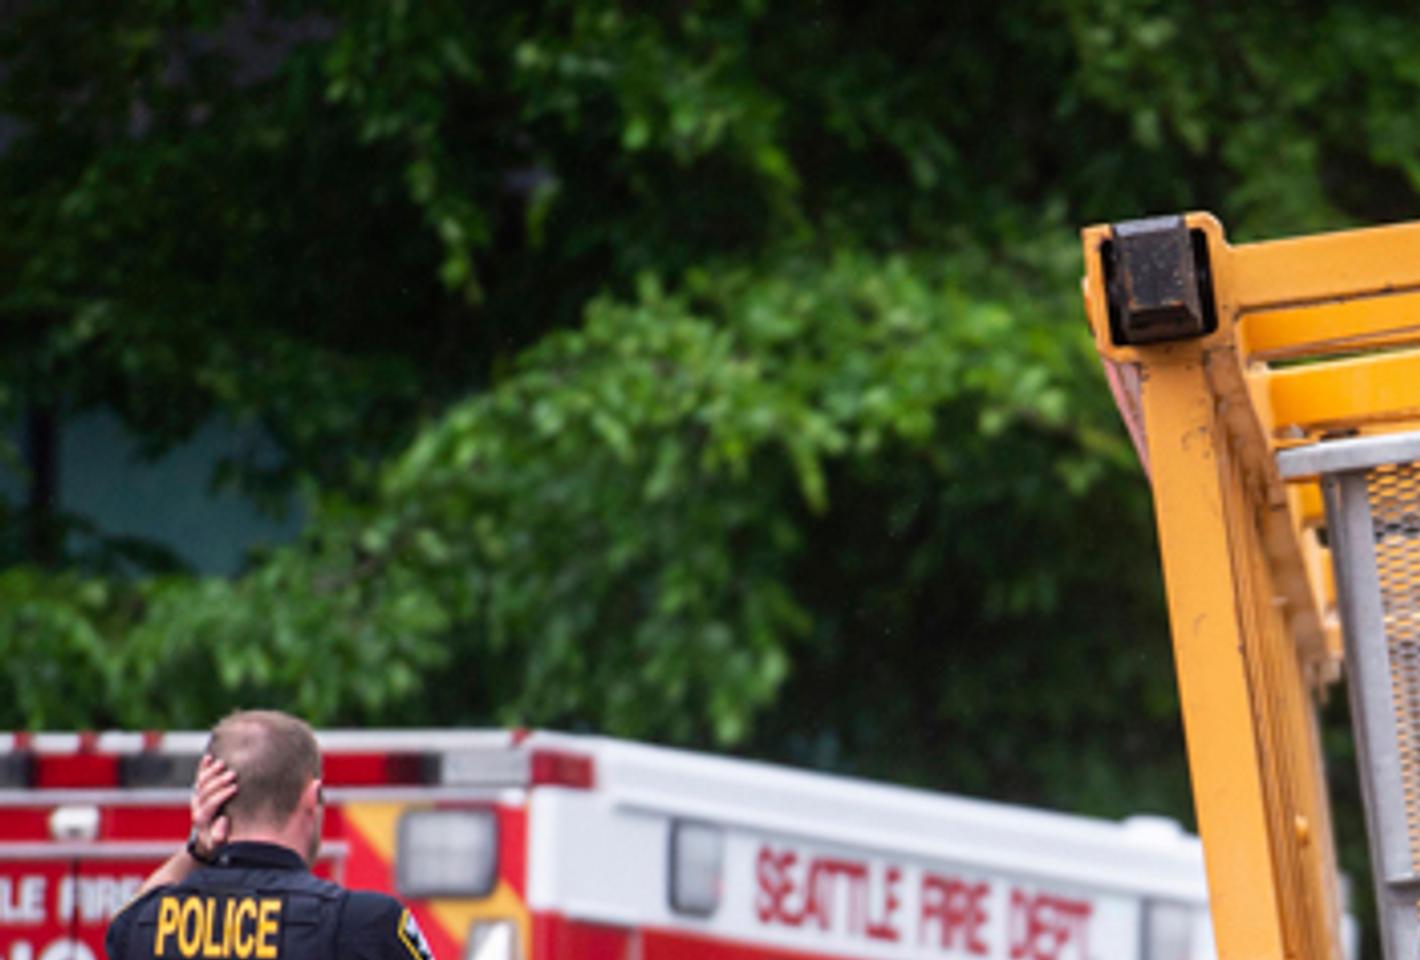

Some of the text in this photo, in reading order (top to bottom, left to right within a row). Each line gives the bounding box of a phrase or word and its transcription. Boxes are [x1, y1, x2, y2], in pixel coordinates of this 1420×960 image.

[154, 896, 282, 960] POLICE
[756, 844, 901, 944] SEATTLE
[921, 871, 991, 957] FIRE
